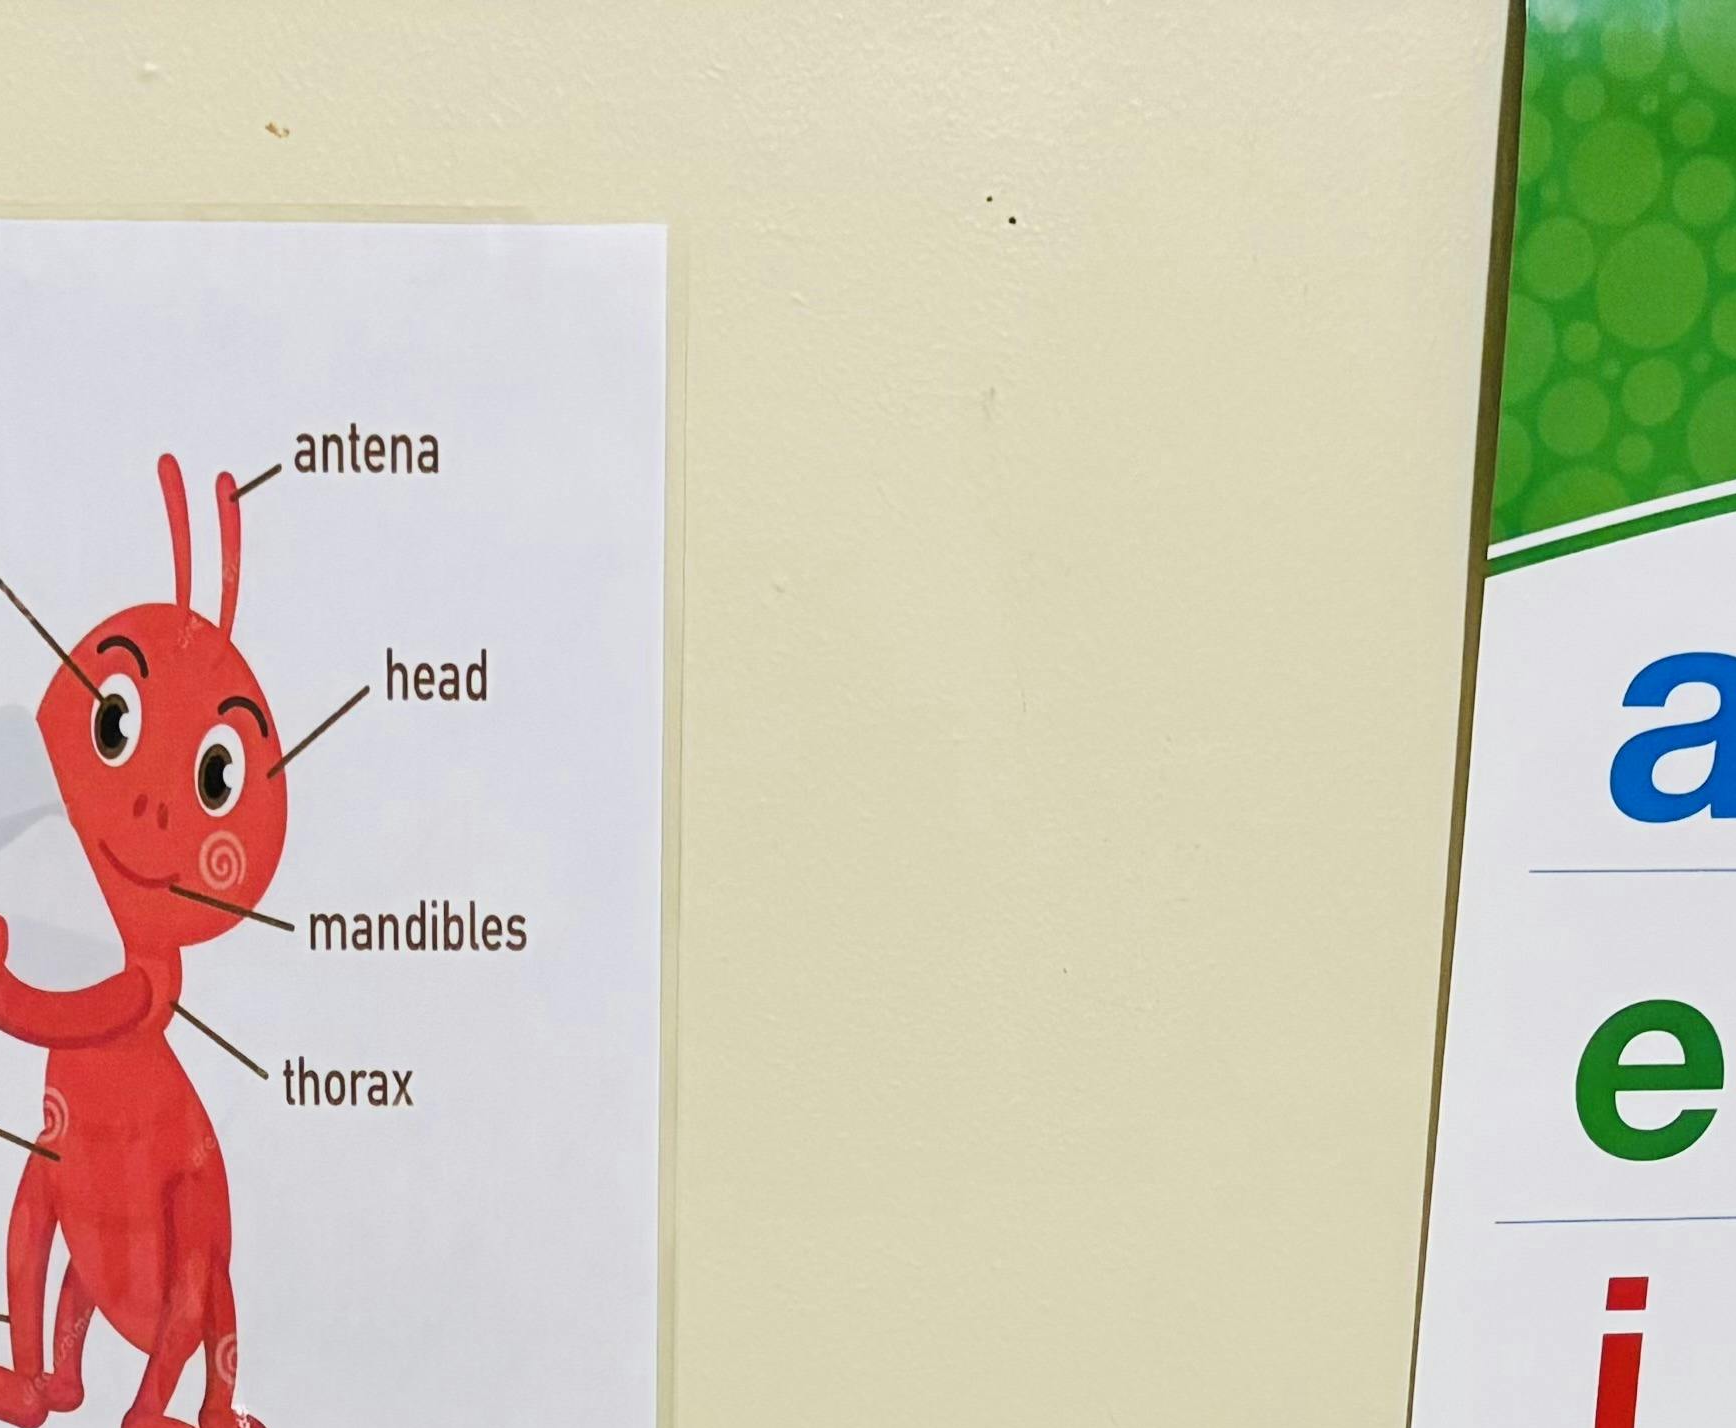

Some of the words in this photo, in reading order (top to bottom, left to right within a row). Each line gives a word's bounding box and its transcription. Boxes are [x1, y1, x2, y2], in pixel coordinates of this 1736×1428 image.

[293, 422, 439, 475] antena
[386, 647, 488, 702] head
[309, 899, 528, 952] mandibles
[282, 1055, 414, 1107] thorax
[1575, 999, 1725, 1162] e
